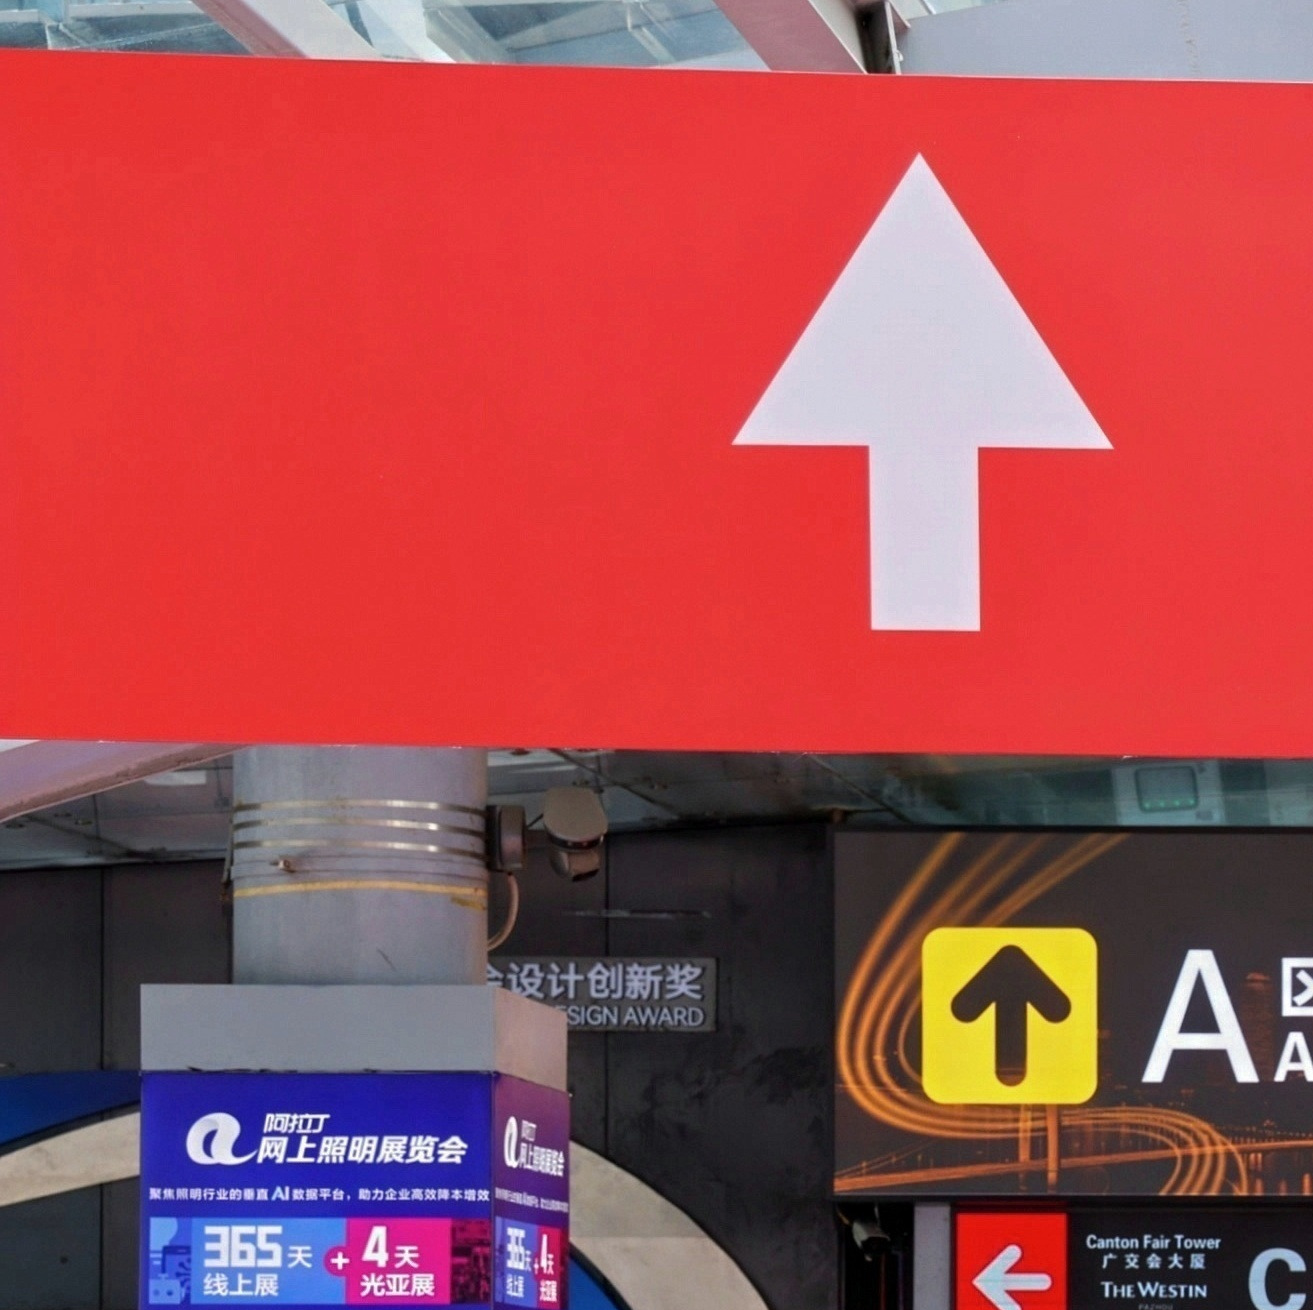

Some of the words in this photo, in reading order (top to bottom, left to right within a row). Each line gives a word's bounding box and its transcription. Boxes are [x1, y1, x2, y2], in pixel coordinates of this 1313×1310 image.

[555, 1005, 618, 1027] SIGN
[624, 1006, 705, 1027] AWARD
[1141, 949, 1260, 1083] A
[262, 1112, 331, 1133] 阿拉丁
[256, 1135, 469, 1164] 网上照明展览会
[203, 1225, 283, 1268] 365
[287, 1245, 312, 1268] 天
[361, 1225, 389, 1268] 4
[394, 1245, 419, 1269] 天
[1086, 1234, 1139, 1250] Canton
[1143, 1234, 1170, 1250] Fair
[1174, 1234, 1222, 1250] Tower
[1101, 1252, 1207, 1270] 广交会大厦
[203, 1273, 280, 1297] 线上展
[359, 1273, 436, 1298] 光亚展
[1100, 1281, 1136, 1299] THE
[1137, 1280, 1208, 1299] WESTIN
